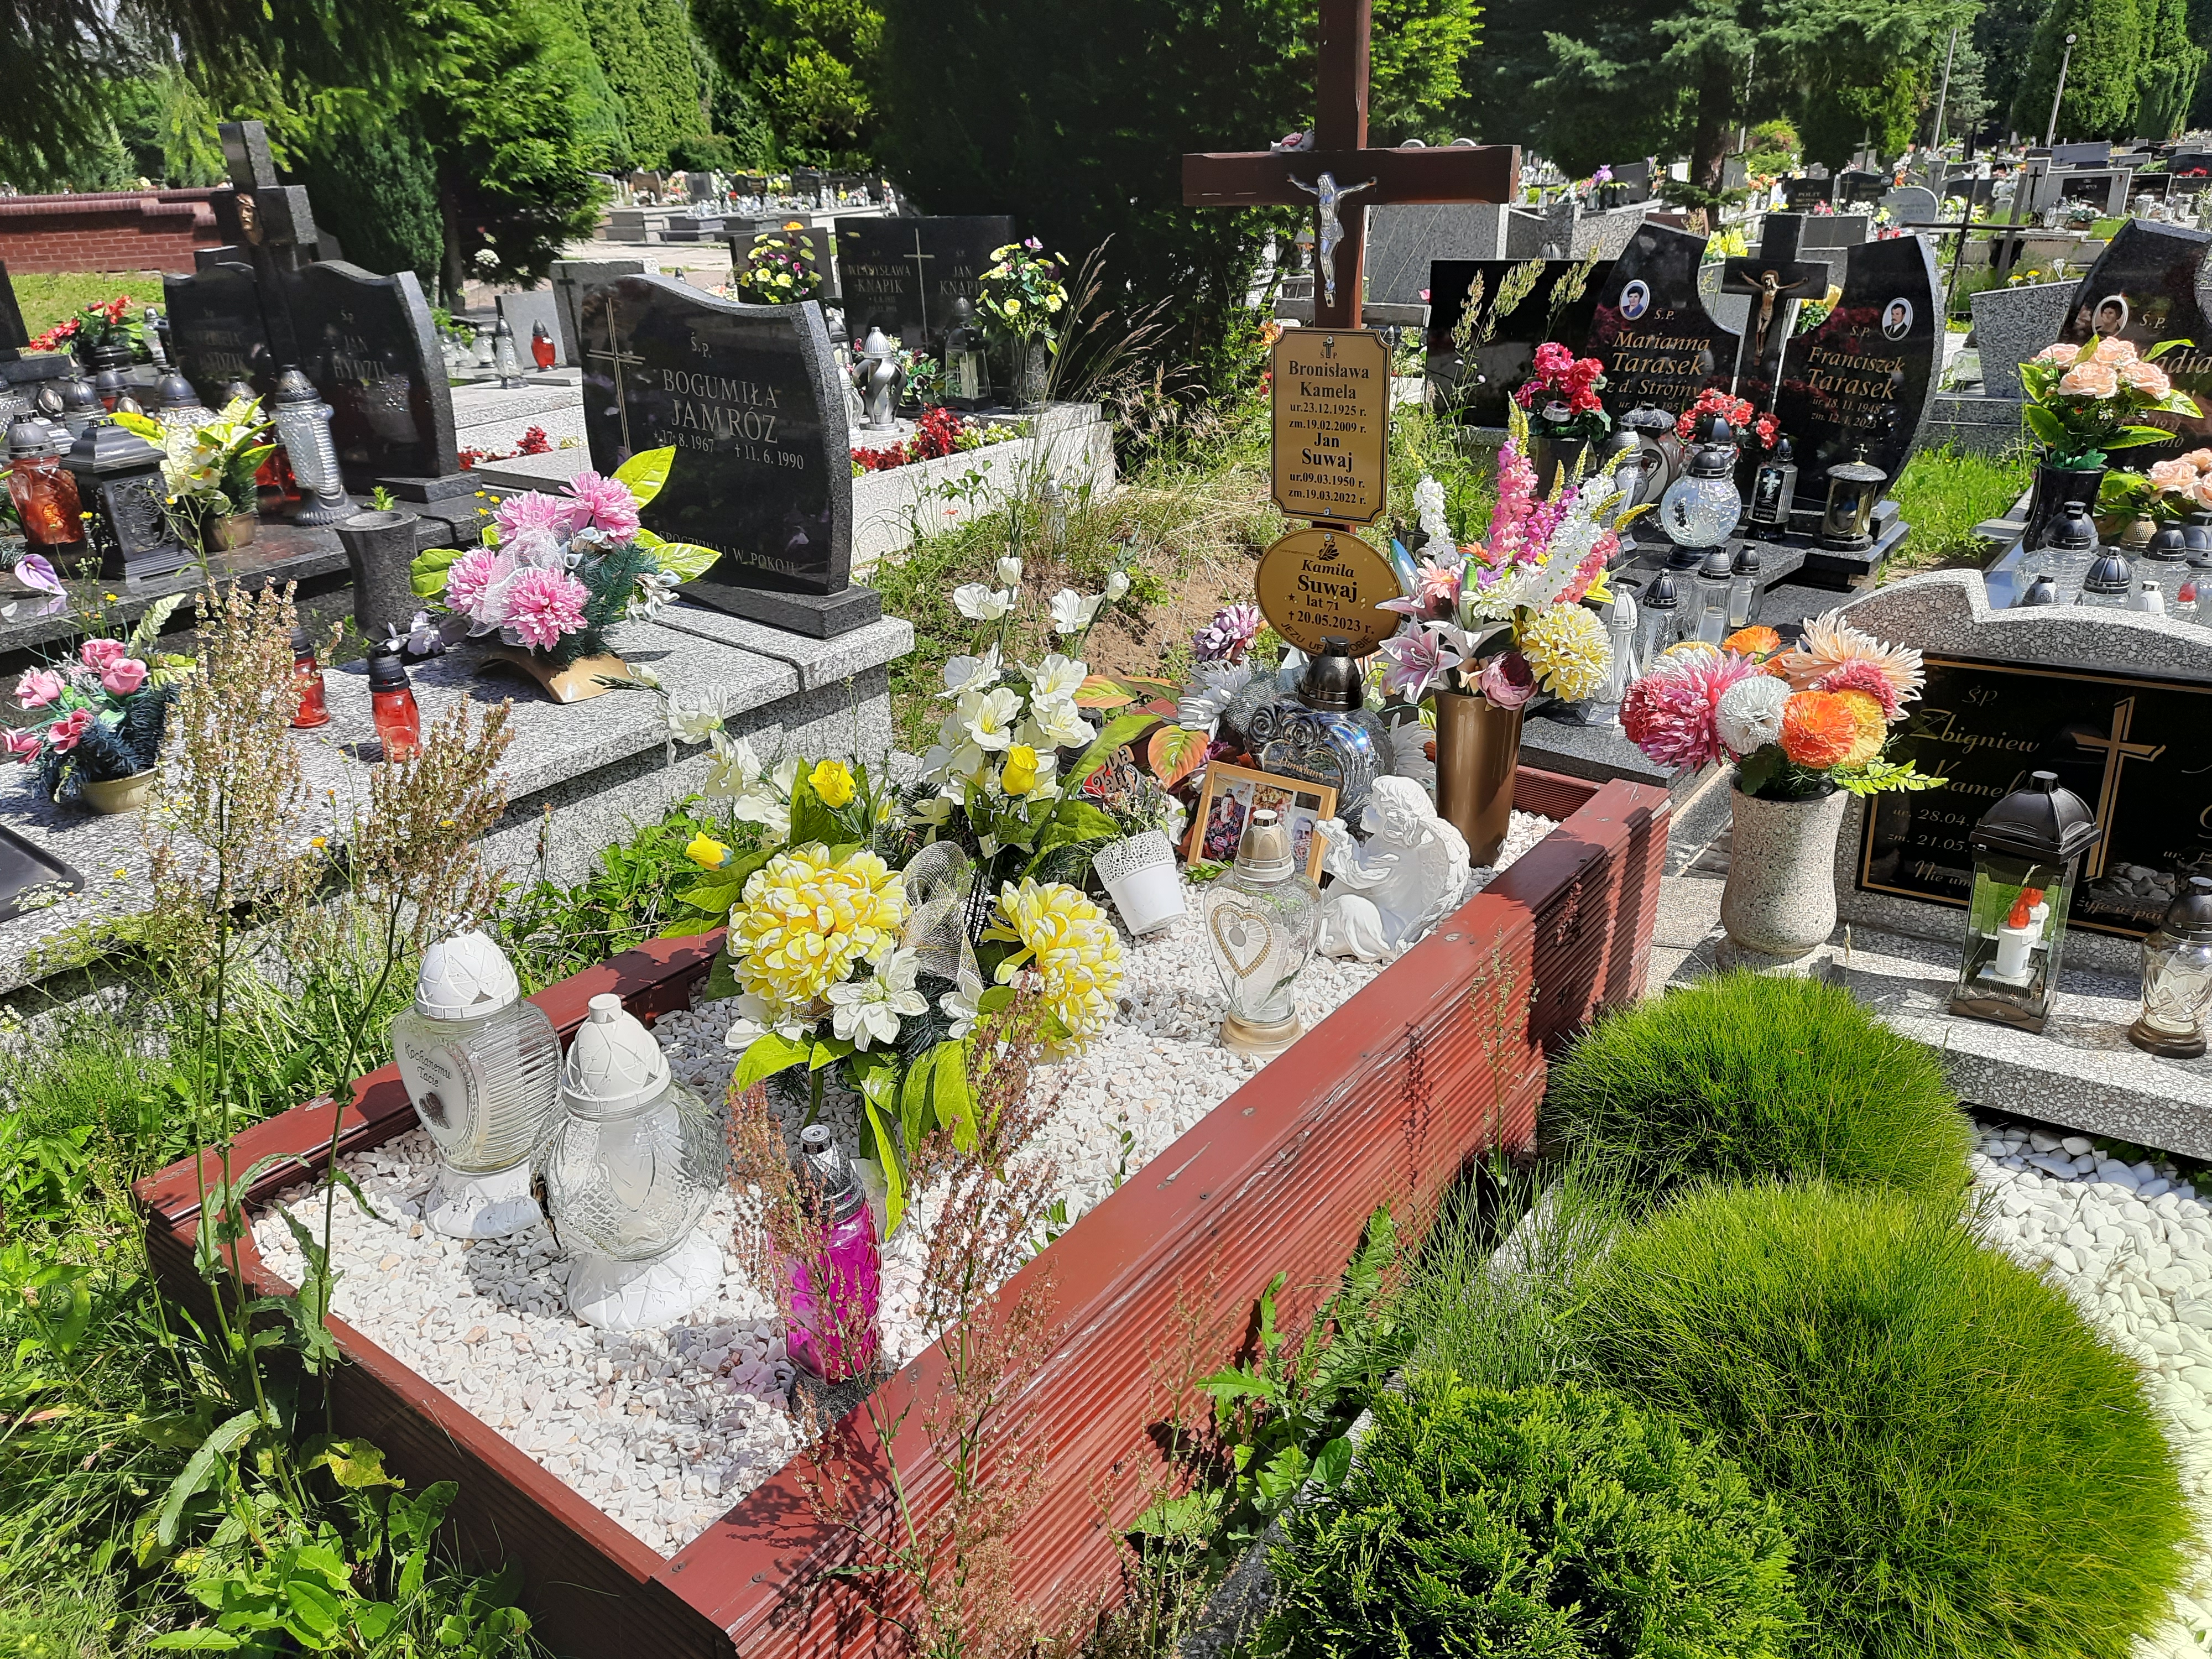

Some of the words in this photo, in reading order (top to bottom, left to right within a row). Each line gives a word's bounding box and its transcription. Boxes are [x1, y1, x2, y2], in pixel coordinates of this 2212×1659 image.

[953, 265, 972, 278] JAN
[857, 279, 904, 294] KNAPIK
[1613, 331, 1711, 351] Marianna
[1288, 360, 1370, 379] Bronisława
[1612, 352, 1705, 376] Tarasek
[1807, 346, 1906, 374] Franciszek
[662, 368, 779, 409] BOGUMIŁA
[1300, 381, 1357, 400] Kamela
[1606, 382, 1615, 394] z
[1619, 379, 1632, 394] d.
[1638, 379, 1702, 401] Strojny
[1807, 368, 1897, 400] Tarasek
[1290, 401, 1357, 416] ur.23.12.1925
[1359, 408, 1367, 417] r.
[1857, 403, 1880, 415] 1948
[671, 399, 779, 444] JAMRÓZ
[1288, 419, 1358, 432] zm.19.02.2009
[1360, 425, 1367, 434] r.
[1853, 418, 1877, 429] 2023
[690, 435, 714, 452] 1967
[1314, 432, 1340, 448] Jan
[763, 448, 774, 465] 6.
[777, 451, 804, 470] 1990
[1302, 448, 1353, 473] Suwaj
[1290, 472, 1355, 487] ur.09.03.1950
[1358, 480, 1365, 489] r.
[1288, 489, 1357, 504] zm.19.03.2022
[733, 547, 744, 562] W
[1301, 559, 1354, 578] Kamila
[1297, 575, 1358, 603] Suwaj
[1306, 594, 1324, 608] lat
[1327, 601, 1339, 612] 71
[1297, 610, 1361, 632] 20.05.2023
[1365, 624, 1375, 635] r.
[1281, 623, 1306, 643] JEZU
[1347, 634, 1374, 653] OBIE
[1908, 708, 2040, 754] Zbigniew
[1933, 759, 2027, 797] Kamel
[1917, 808, 1969, 826] 28.04.
[1887, 833, 1910, 843] zm.
[1916, 834, 1968, 852] 21.05.
[1914, 860, 1943, 881] Nie
[404, 1041, 451, 1080] Kochanemu
